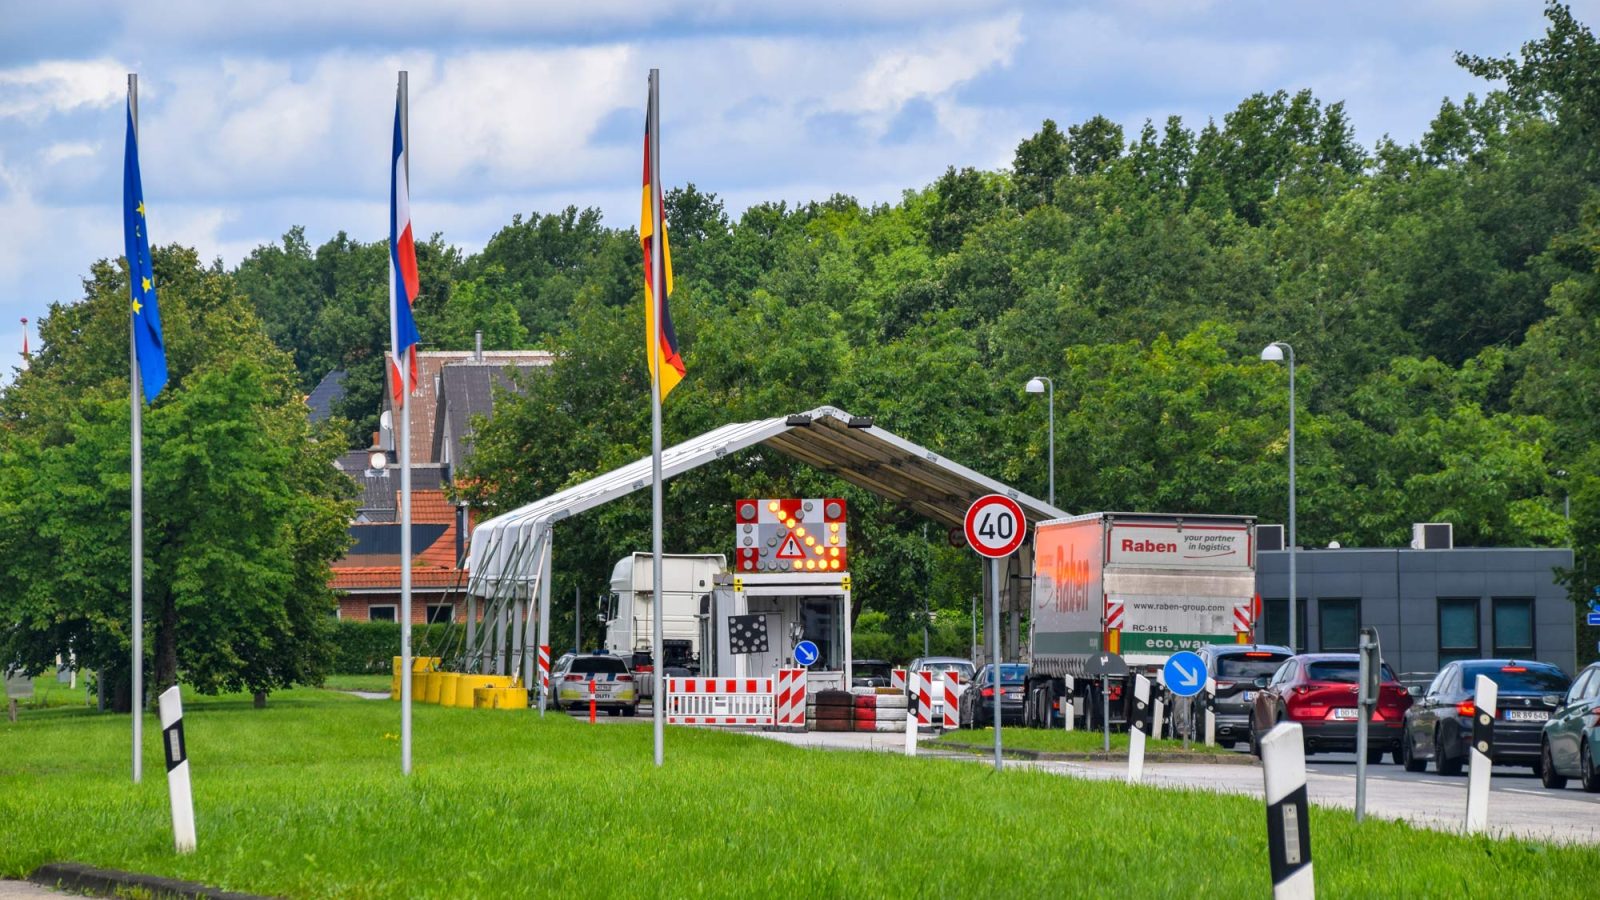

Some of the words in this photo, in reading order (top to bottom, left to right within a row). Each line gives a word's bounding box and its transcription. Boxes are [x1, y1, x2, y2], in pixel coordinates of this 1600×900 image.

[979, 512, 1013, 540] 40
[1184, 534, 1203, 543] your
[1121, 539, 1177, 553] Raben
[1198, 543, 1231, 552] logistics
[1056, 543, 1089, 613] Raben
[1133, 603, 1225, 613] www.raben-group.com
[1132, 624, 1168, 633] RC-9115
[1523, 711, 1532, 719] 89
[1534, 711, 1547, 719] 645
